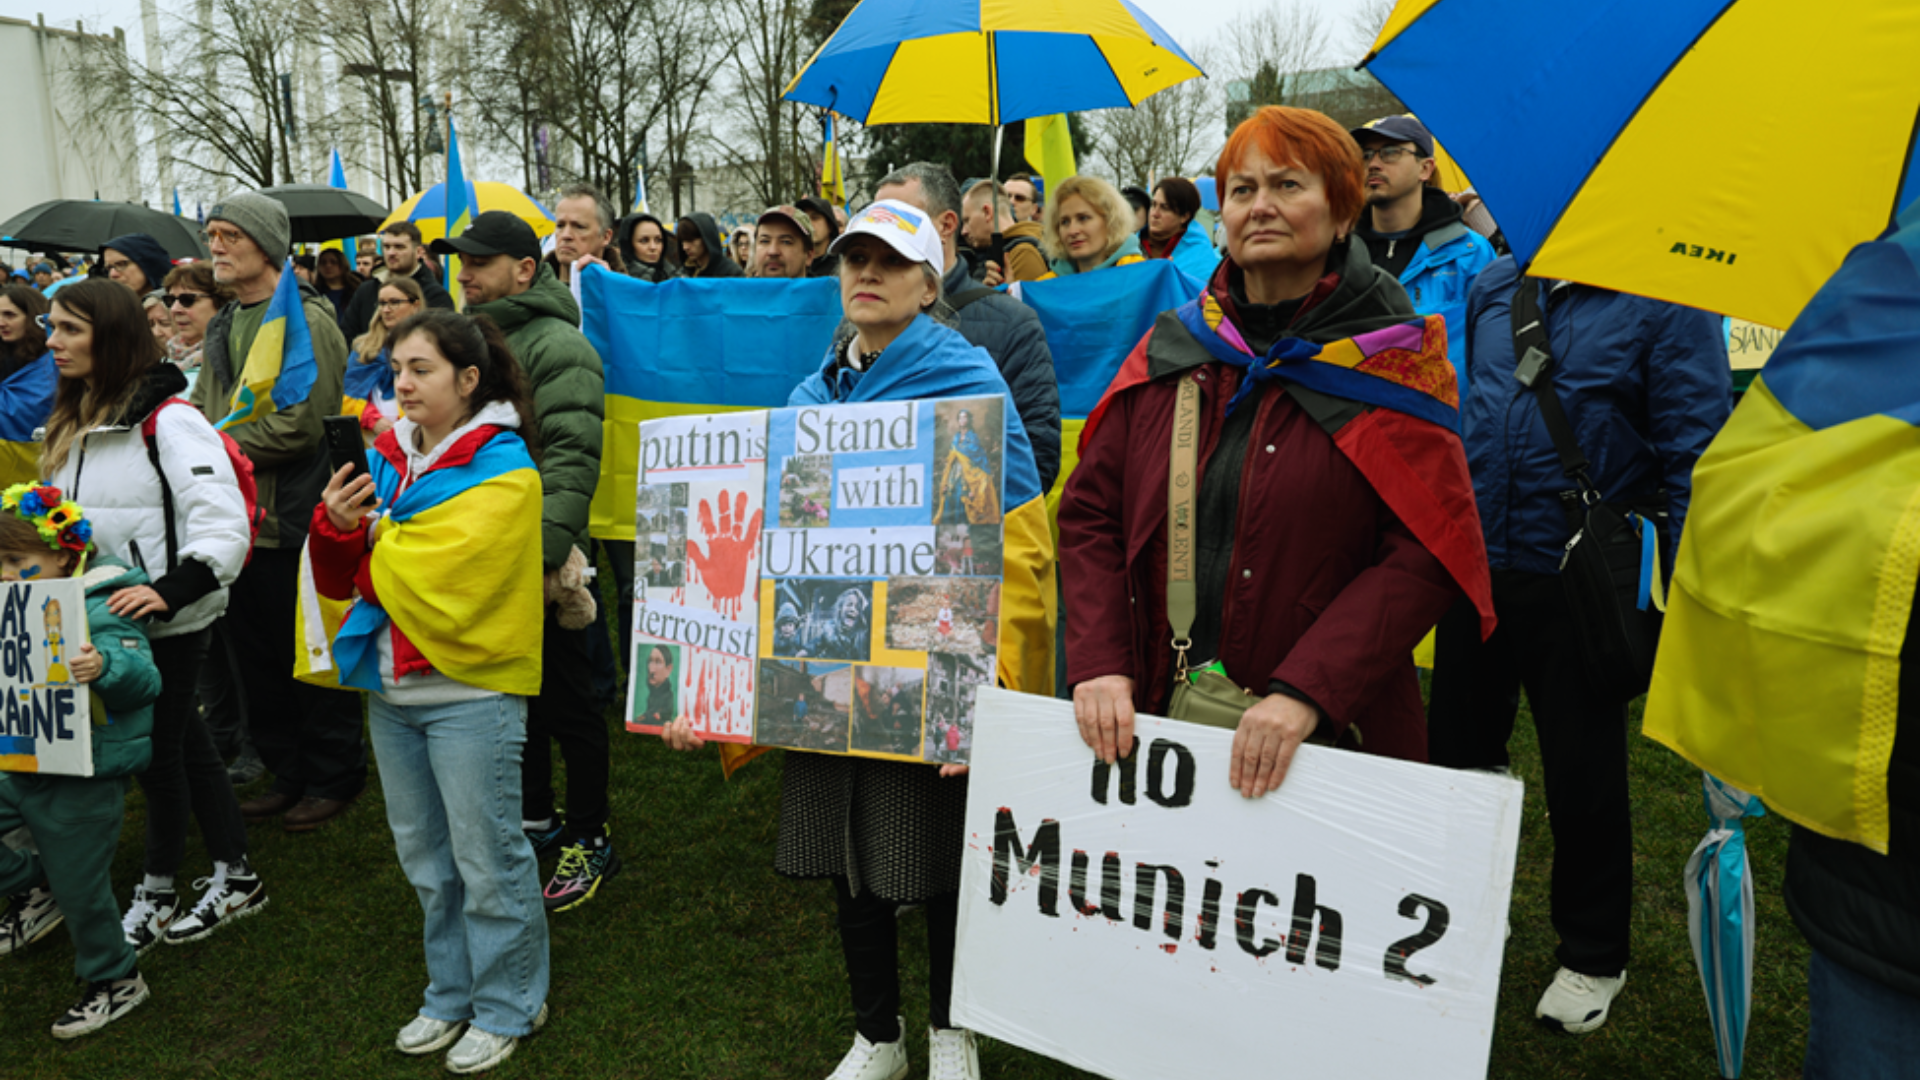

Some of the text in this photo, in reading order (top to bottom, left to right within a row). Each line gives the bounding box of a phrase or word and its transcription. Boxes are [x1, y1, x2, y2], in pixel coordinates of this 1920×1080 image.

[639, 416, 765, 485] putin is
[798, 401, 915, 453] Stand
[840, 466, 920, 508] with
[765, 528, 934, 576] Ukraine
[635, 577, 646, 601] a
[640, 604, 755, 658] terrorist
[0, 632, 34, 684] OR
[989, 806, 1451, 985] Munich 2
